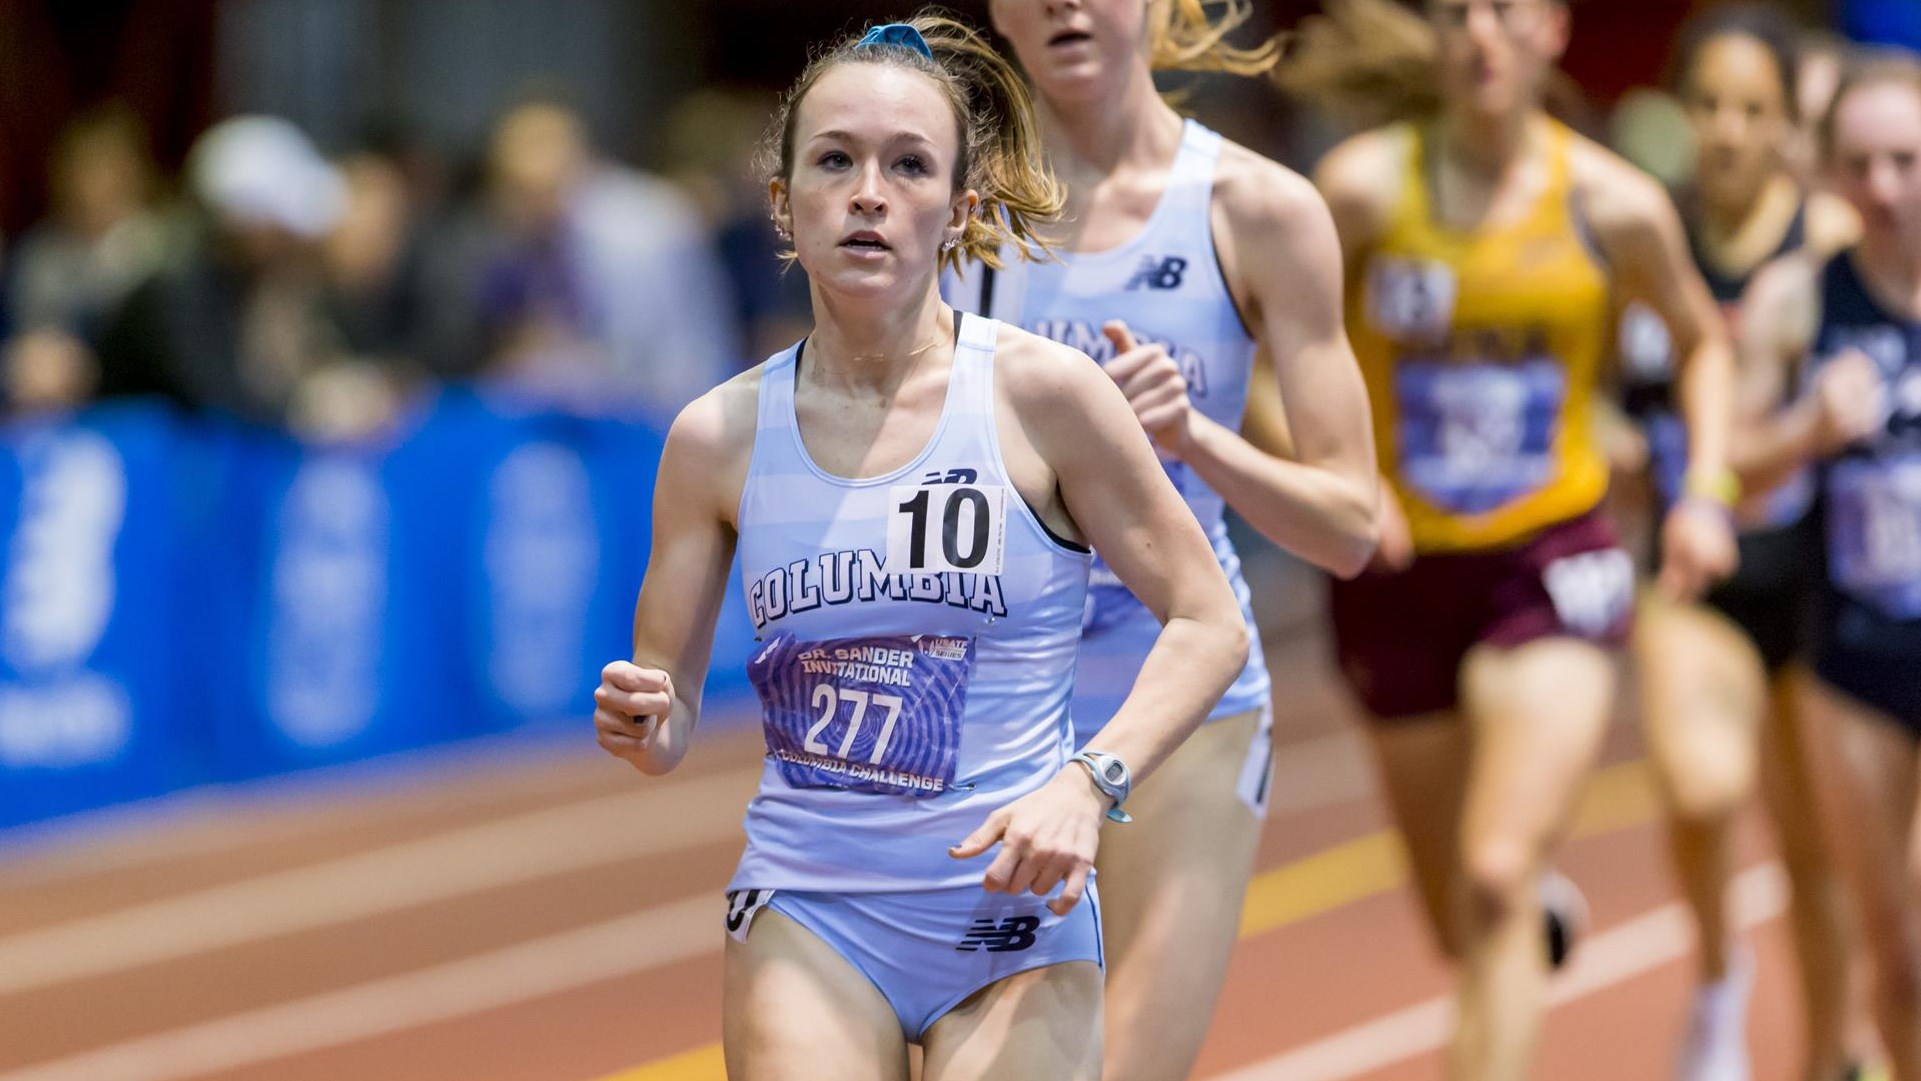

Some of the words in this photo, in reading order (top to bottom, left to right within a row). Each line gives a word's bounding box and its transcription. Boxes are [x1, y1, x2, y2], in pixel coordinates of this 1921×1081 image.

[898, 487, 990, 569] 10
[750, 548, 1008, 629] COLUMBIA
[801, 660, 911, 687] INVITATIONAL
[835, 646, 914, 669] SANDER
[803, 683, 903, 765] 277
[780, 752, 847, 775] COLUMBIA
[849, 763, 944, 792] CHALLENGE
[955, 915, 1040, 952] NB
